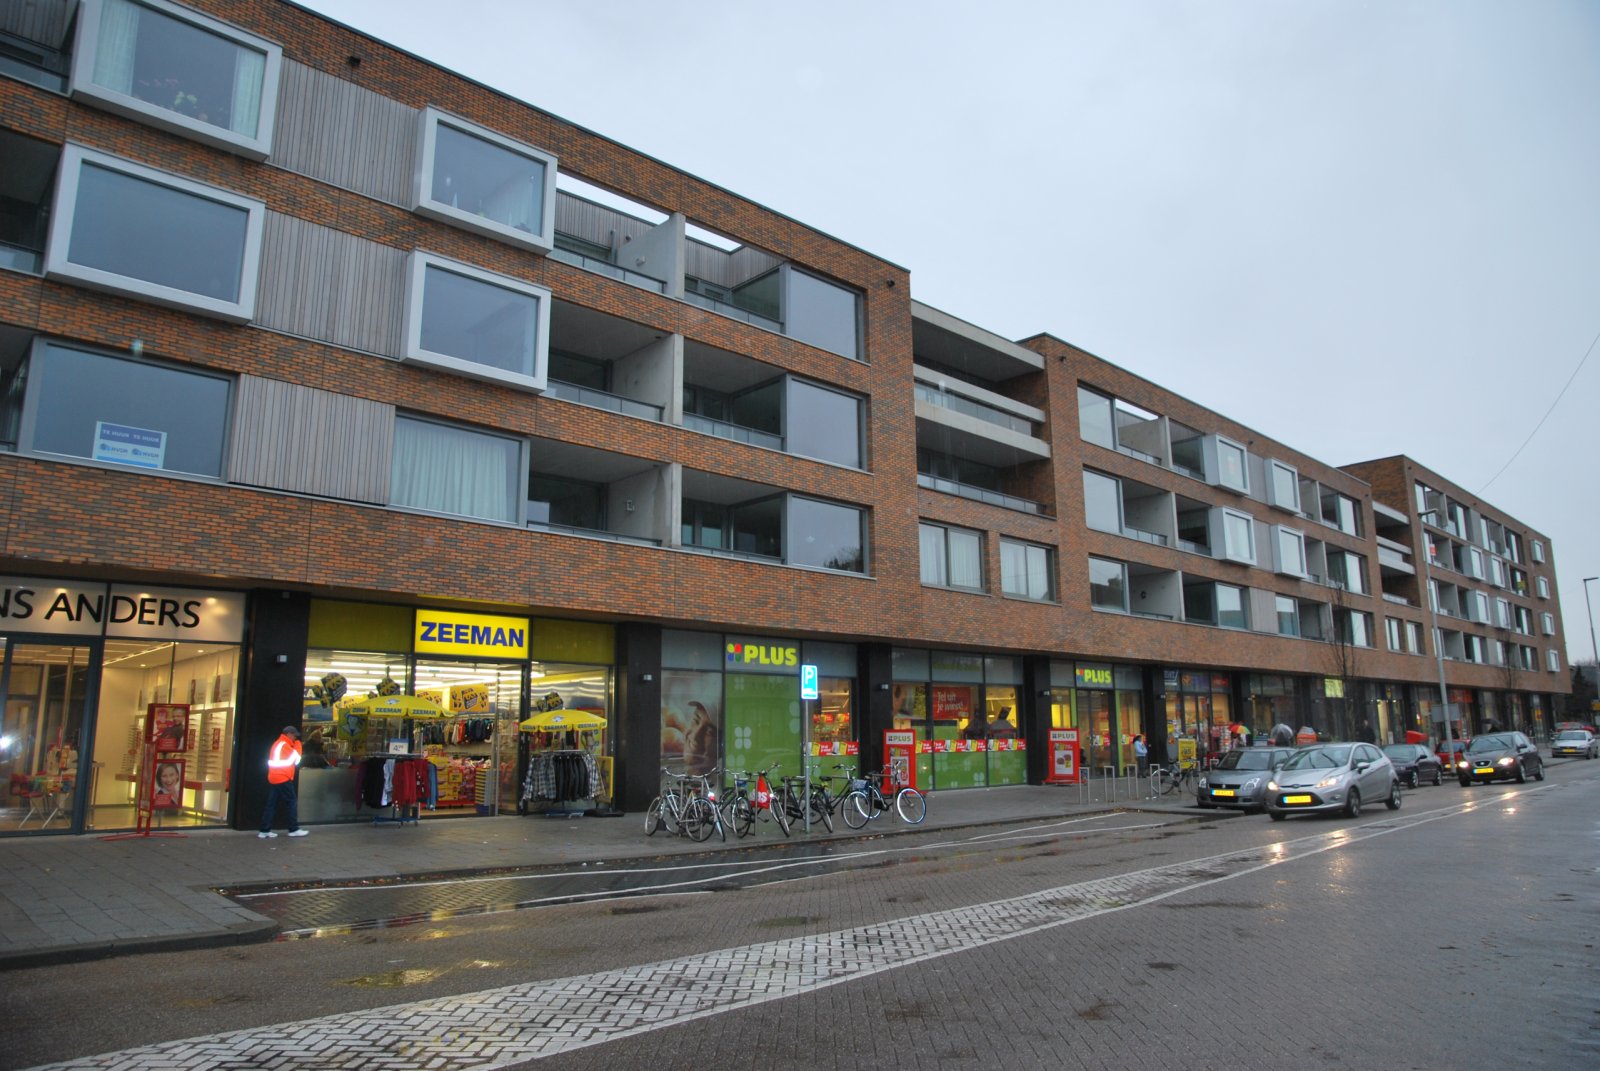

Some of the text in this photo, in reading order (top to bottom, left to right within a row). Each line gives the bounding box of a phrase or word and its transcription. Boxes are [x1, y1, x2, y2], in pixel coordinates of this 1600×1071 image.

[44, 592, 202, 628] ANDERS
[420, 621, 524, 647] ZEEMAN
[744, 644, 797, 666] PLUS
[804, 666, 814, 685] P
[1084, 669, 1112, 684] PLUS
